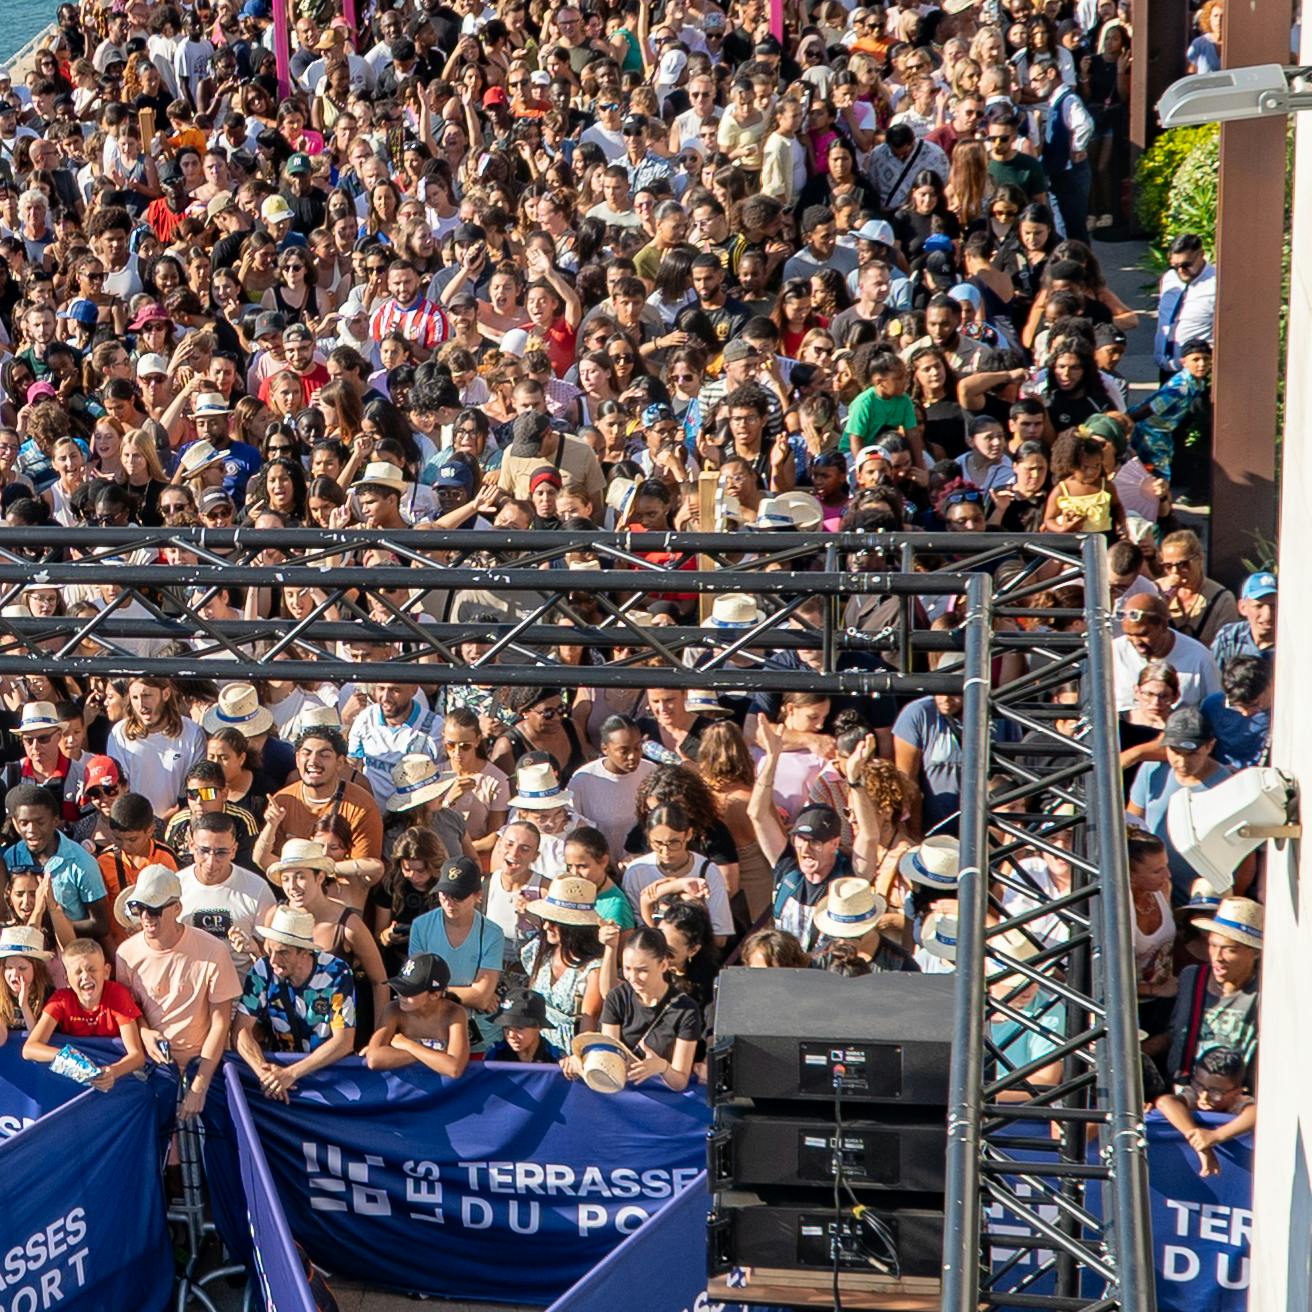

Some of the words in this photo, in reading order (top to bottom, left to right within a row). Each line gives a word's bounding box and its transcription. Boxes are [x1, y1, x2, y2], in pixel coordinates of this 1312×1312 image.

[403, 1159, 445, 1225] LES
[458, 1161, 699, 1199] TERRASSE
[461, 1195, 540, 1235] DU
[578, 1203, 651, 1237] PO
[1163, 1244, 1251, 1291] DU
